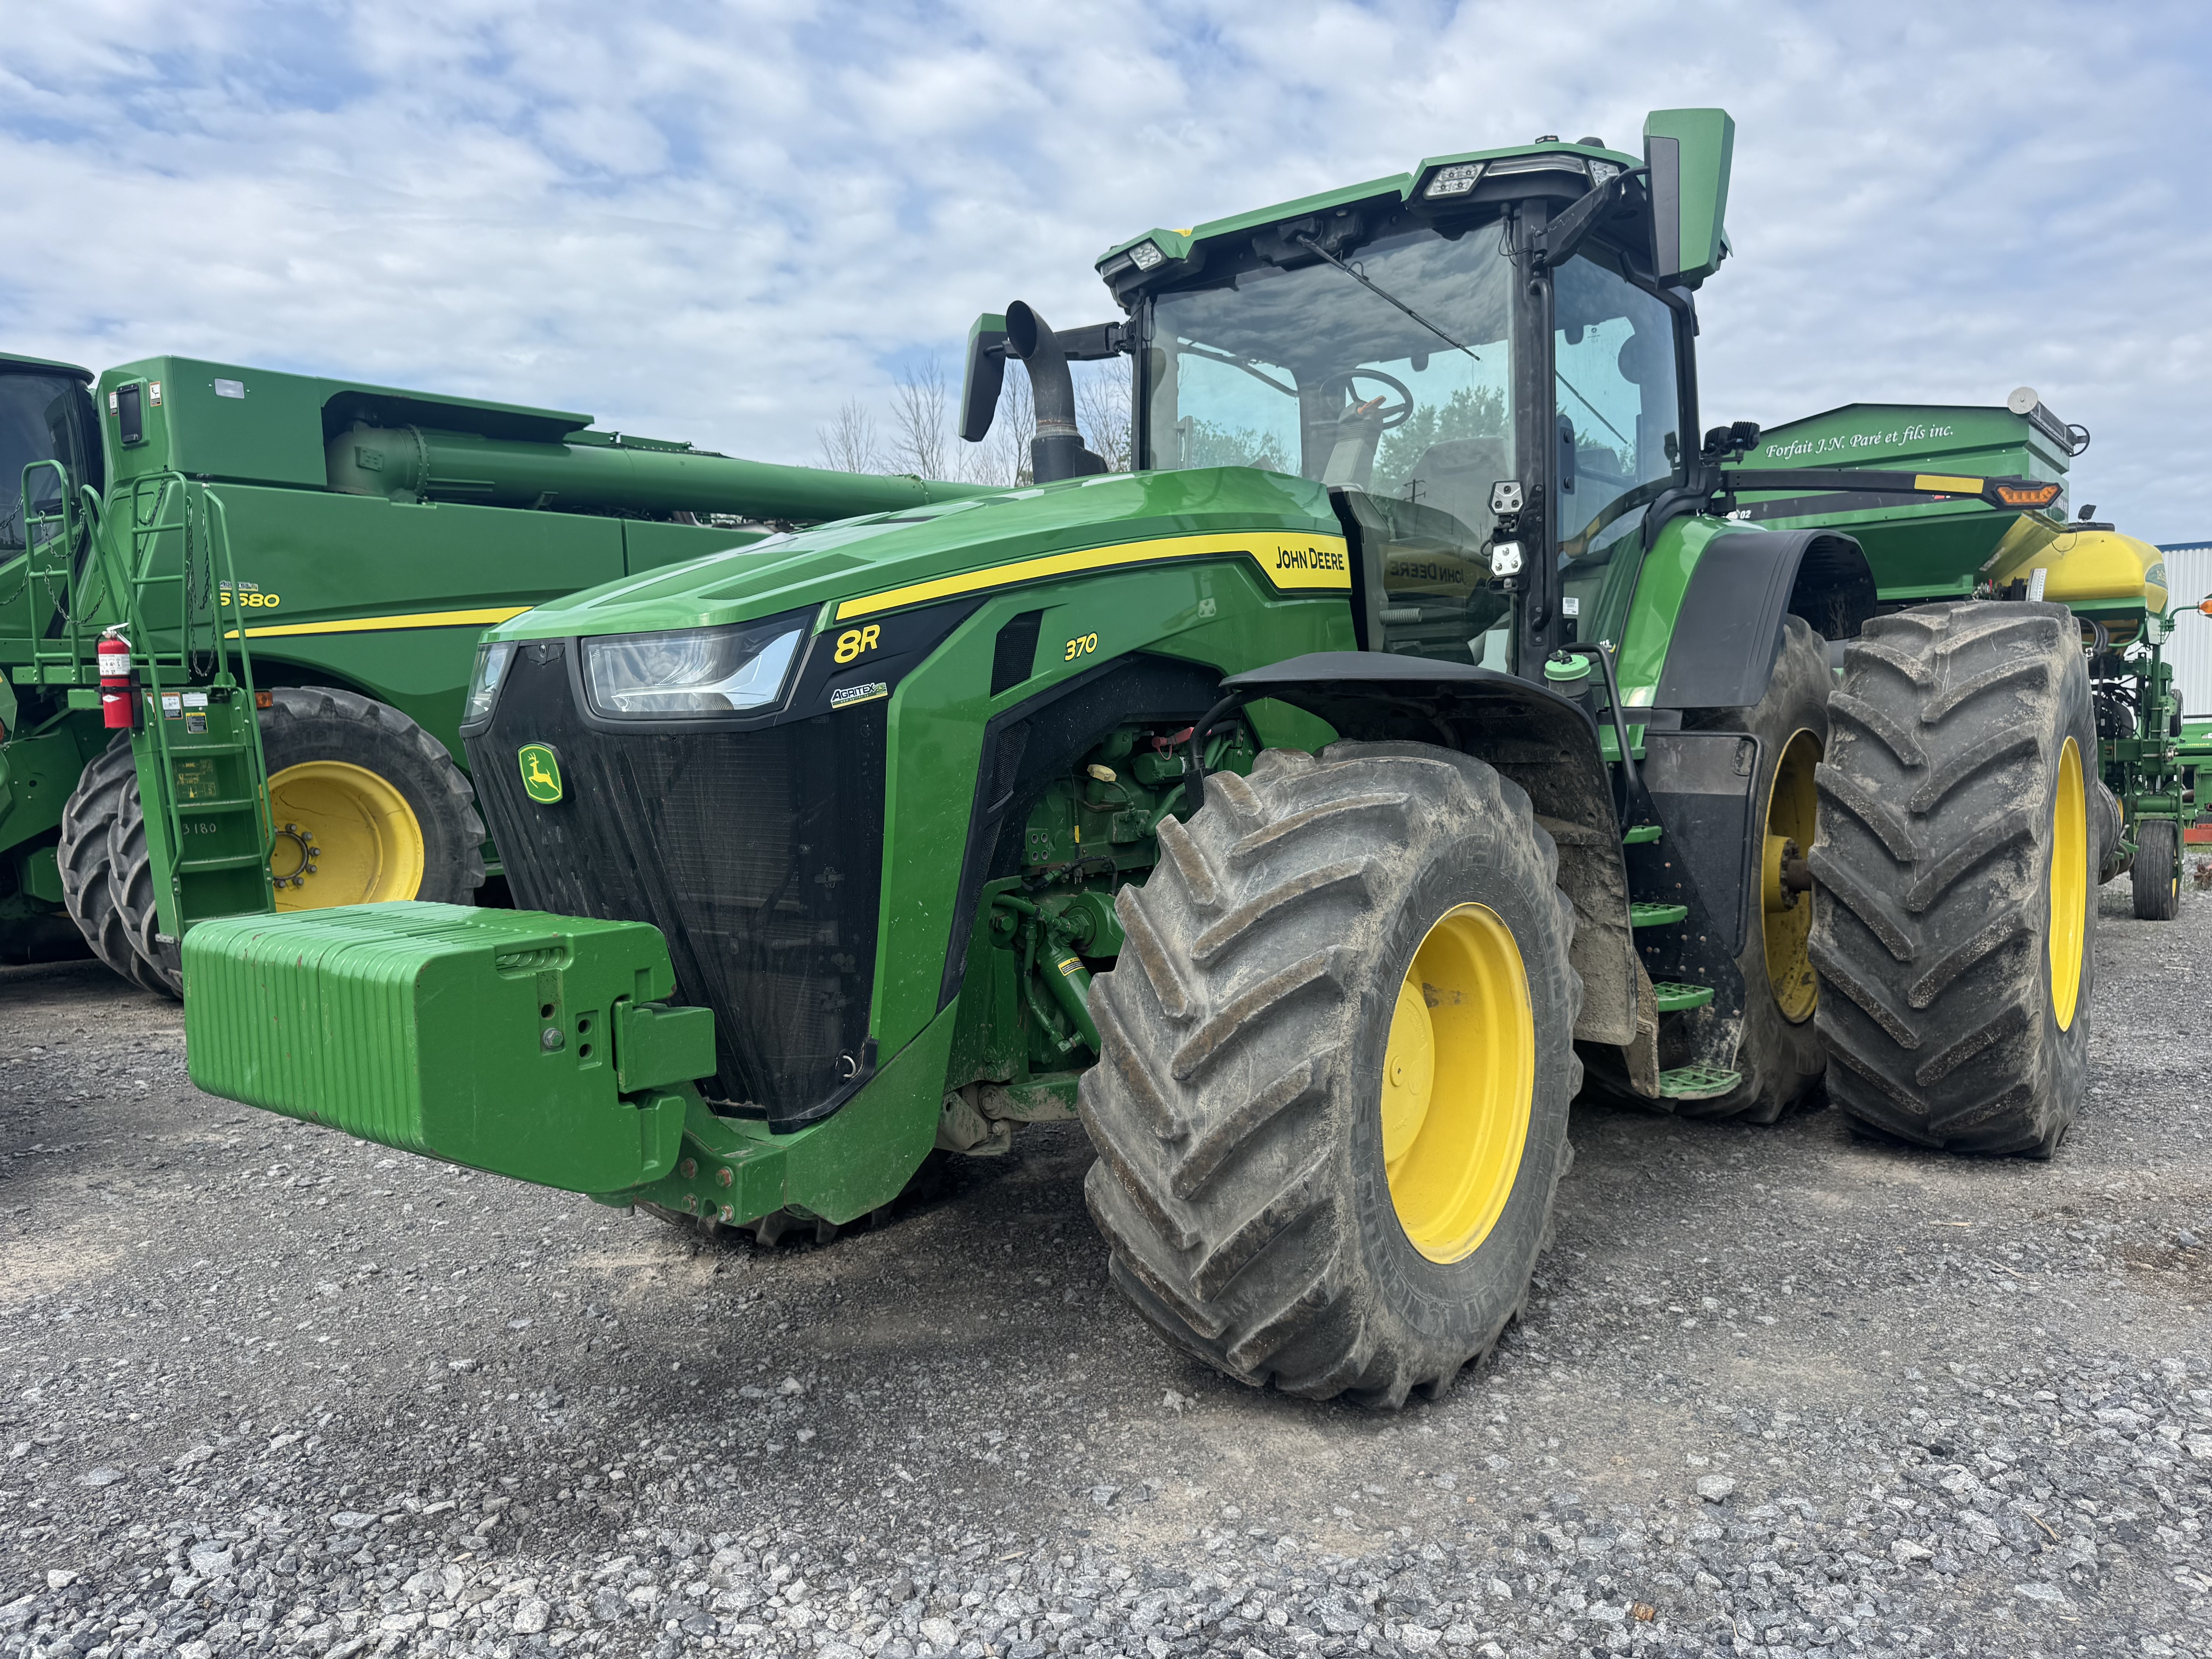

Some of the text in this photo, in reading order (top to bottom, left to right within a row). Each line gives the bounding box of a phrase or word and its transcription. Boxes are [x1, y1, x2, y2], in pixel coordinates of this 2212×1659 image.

[1766, 424, 1953, 460] Forfait J.N. Paré et fils inc.
[1276, 546, 1345, 570] JOHN DEERE
[834, 624, 880, 663] 8R
[1065, 632, 1098, 661] 370
[832, 684, 875, 701] AGRITEX
[183, 823, 216, 835] 3180
